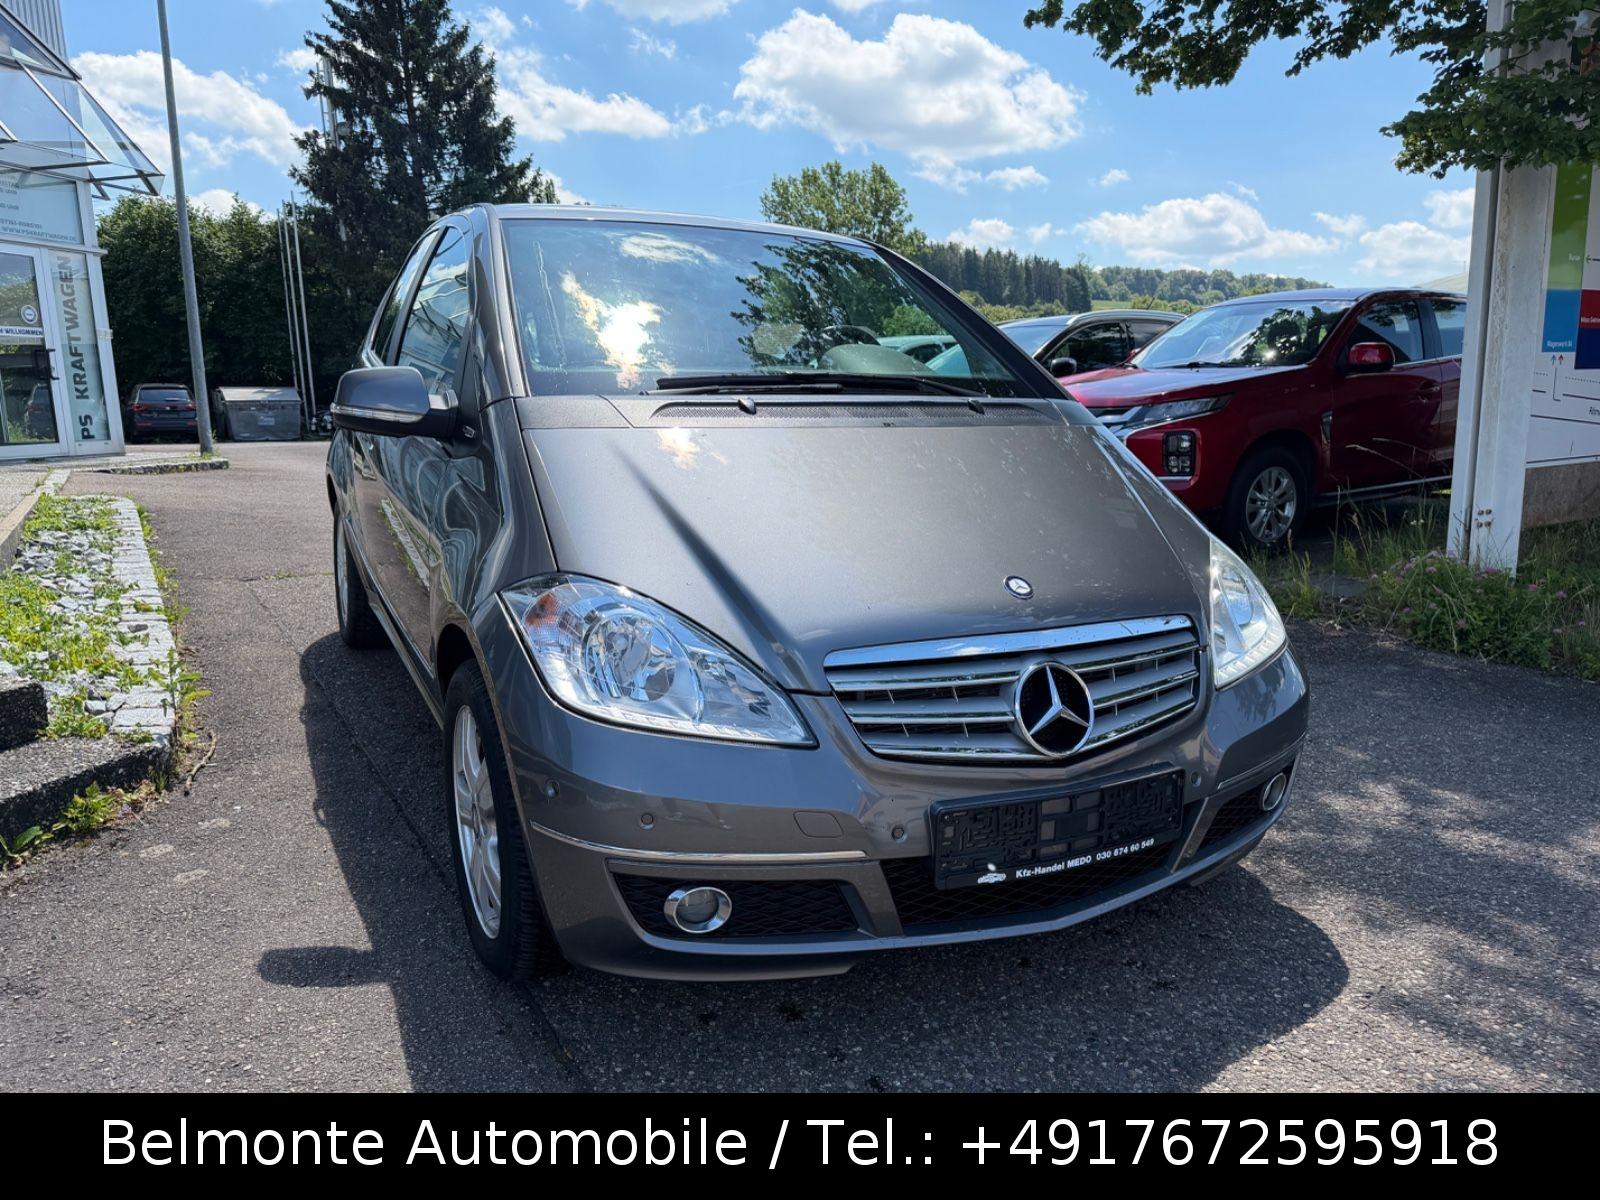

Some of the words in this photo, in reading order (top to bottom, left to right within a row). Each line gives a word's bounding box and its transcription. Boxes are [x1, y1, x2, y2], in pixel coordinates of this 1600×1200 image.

[79, 415, 96, 440] PS
[1015, 861, 1065, 878] Kfz-Handel
[1067, 855, 1092, 868] MEDO
[1096, 850, 1112, 860] 030
[1113, 846, 1128, 857] 674
[1130, 843, 1140, 852] 60
